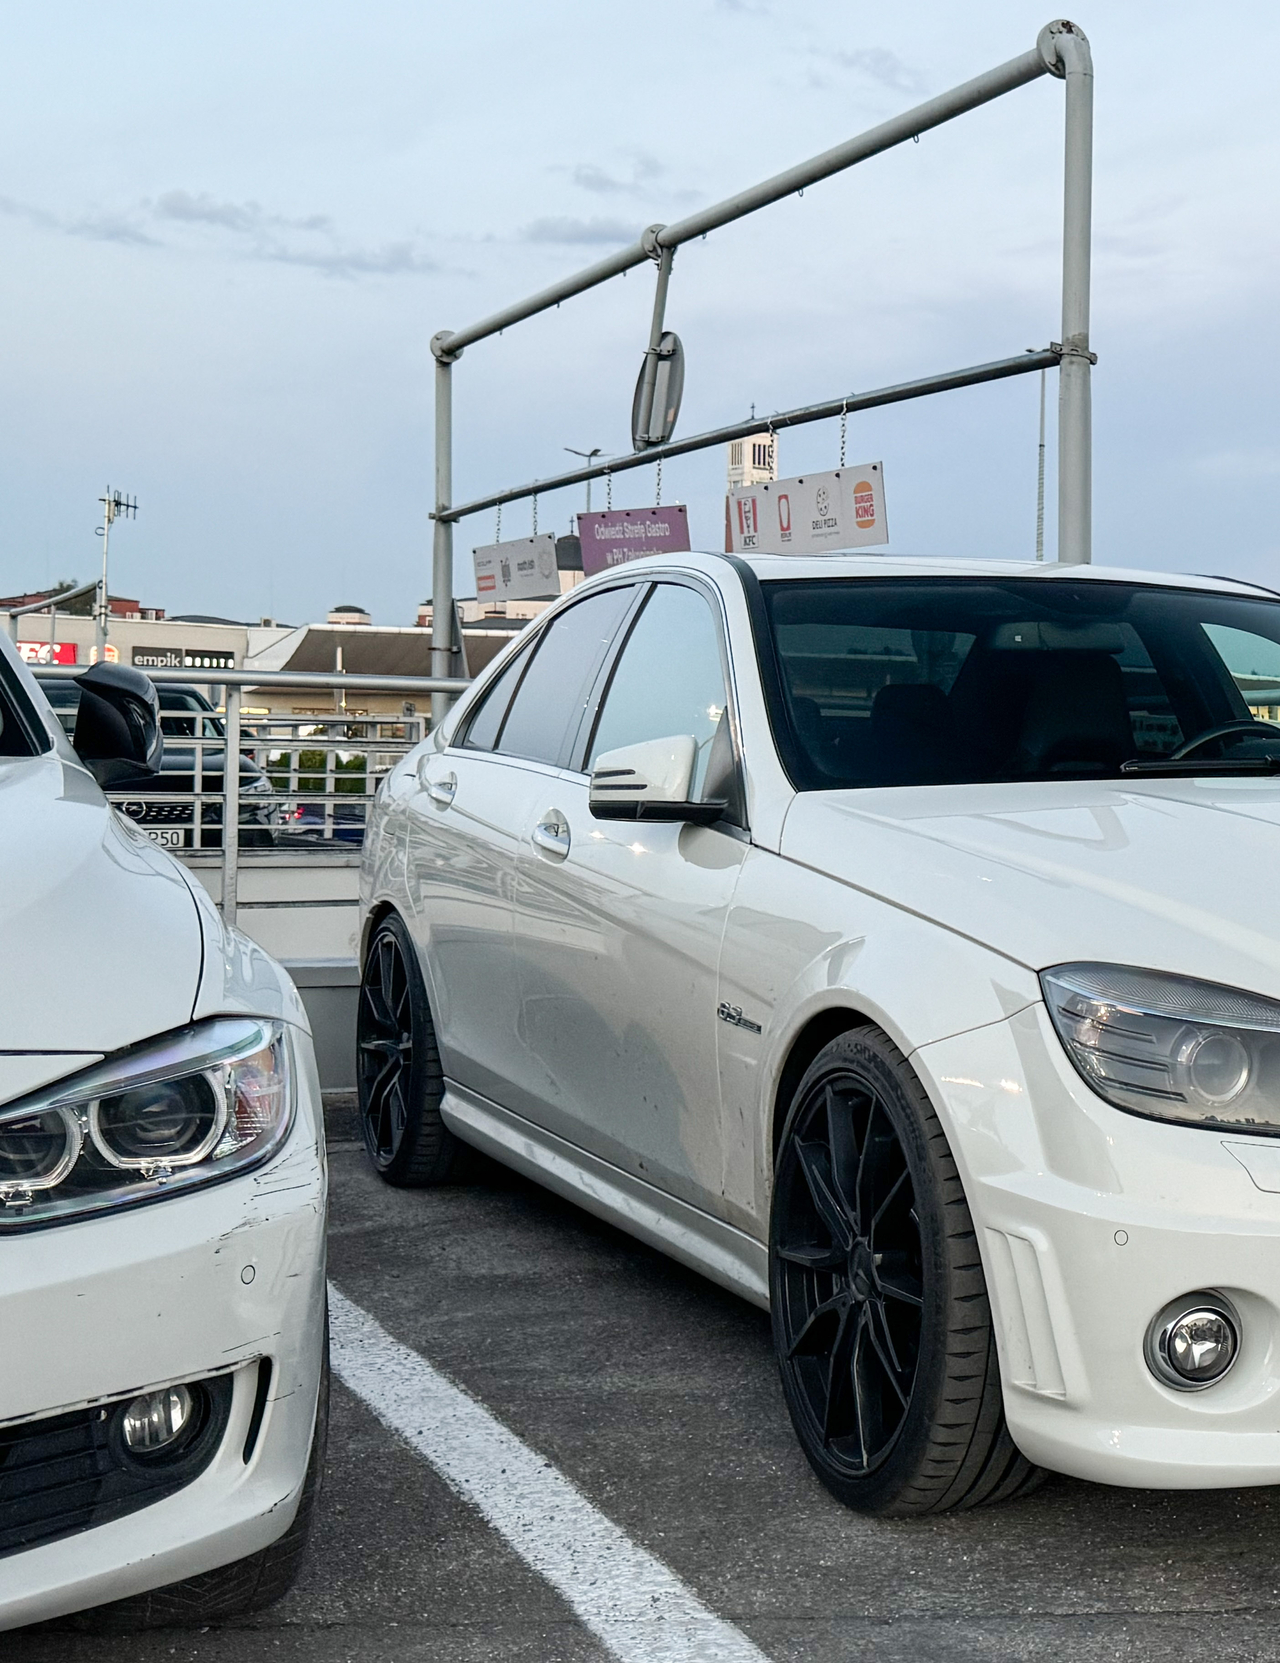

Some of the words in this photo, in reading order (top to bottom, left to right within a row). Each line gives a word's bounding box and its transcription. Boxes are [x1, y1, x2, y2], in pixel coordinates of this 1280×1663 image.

[855, 504, 875, 519] KING
[646, 521, 670, 537] Gastro
[812, 520, 823, 530] DELI
[824, 518, 837, 528] PIZZA
[744, 535, 756, 546] KFC
[613, 548, 624, 564] PH
[134, 652, 180, 667] empik
